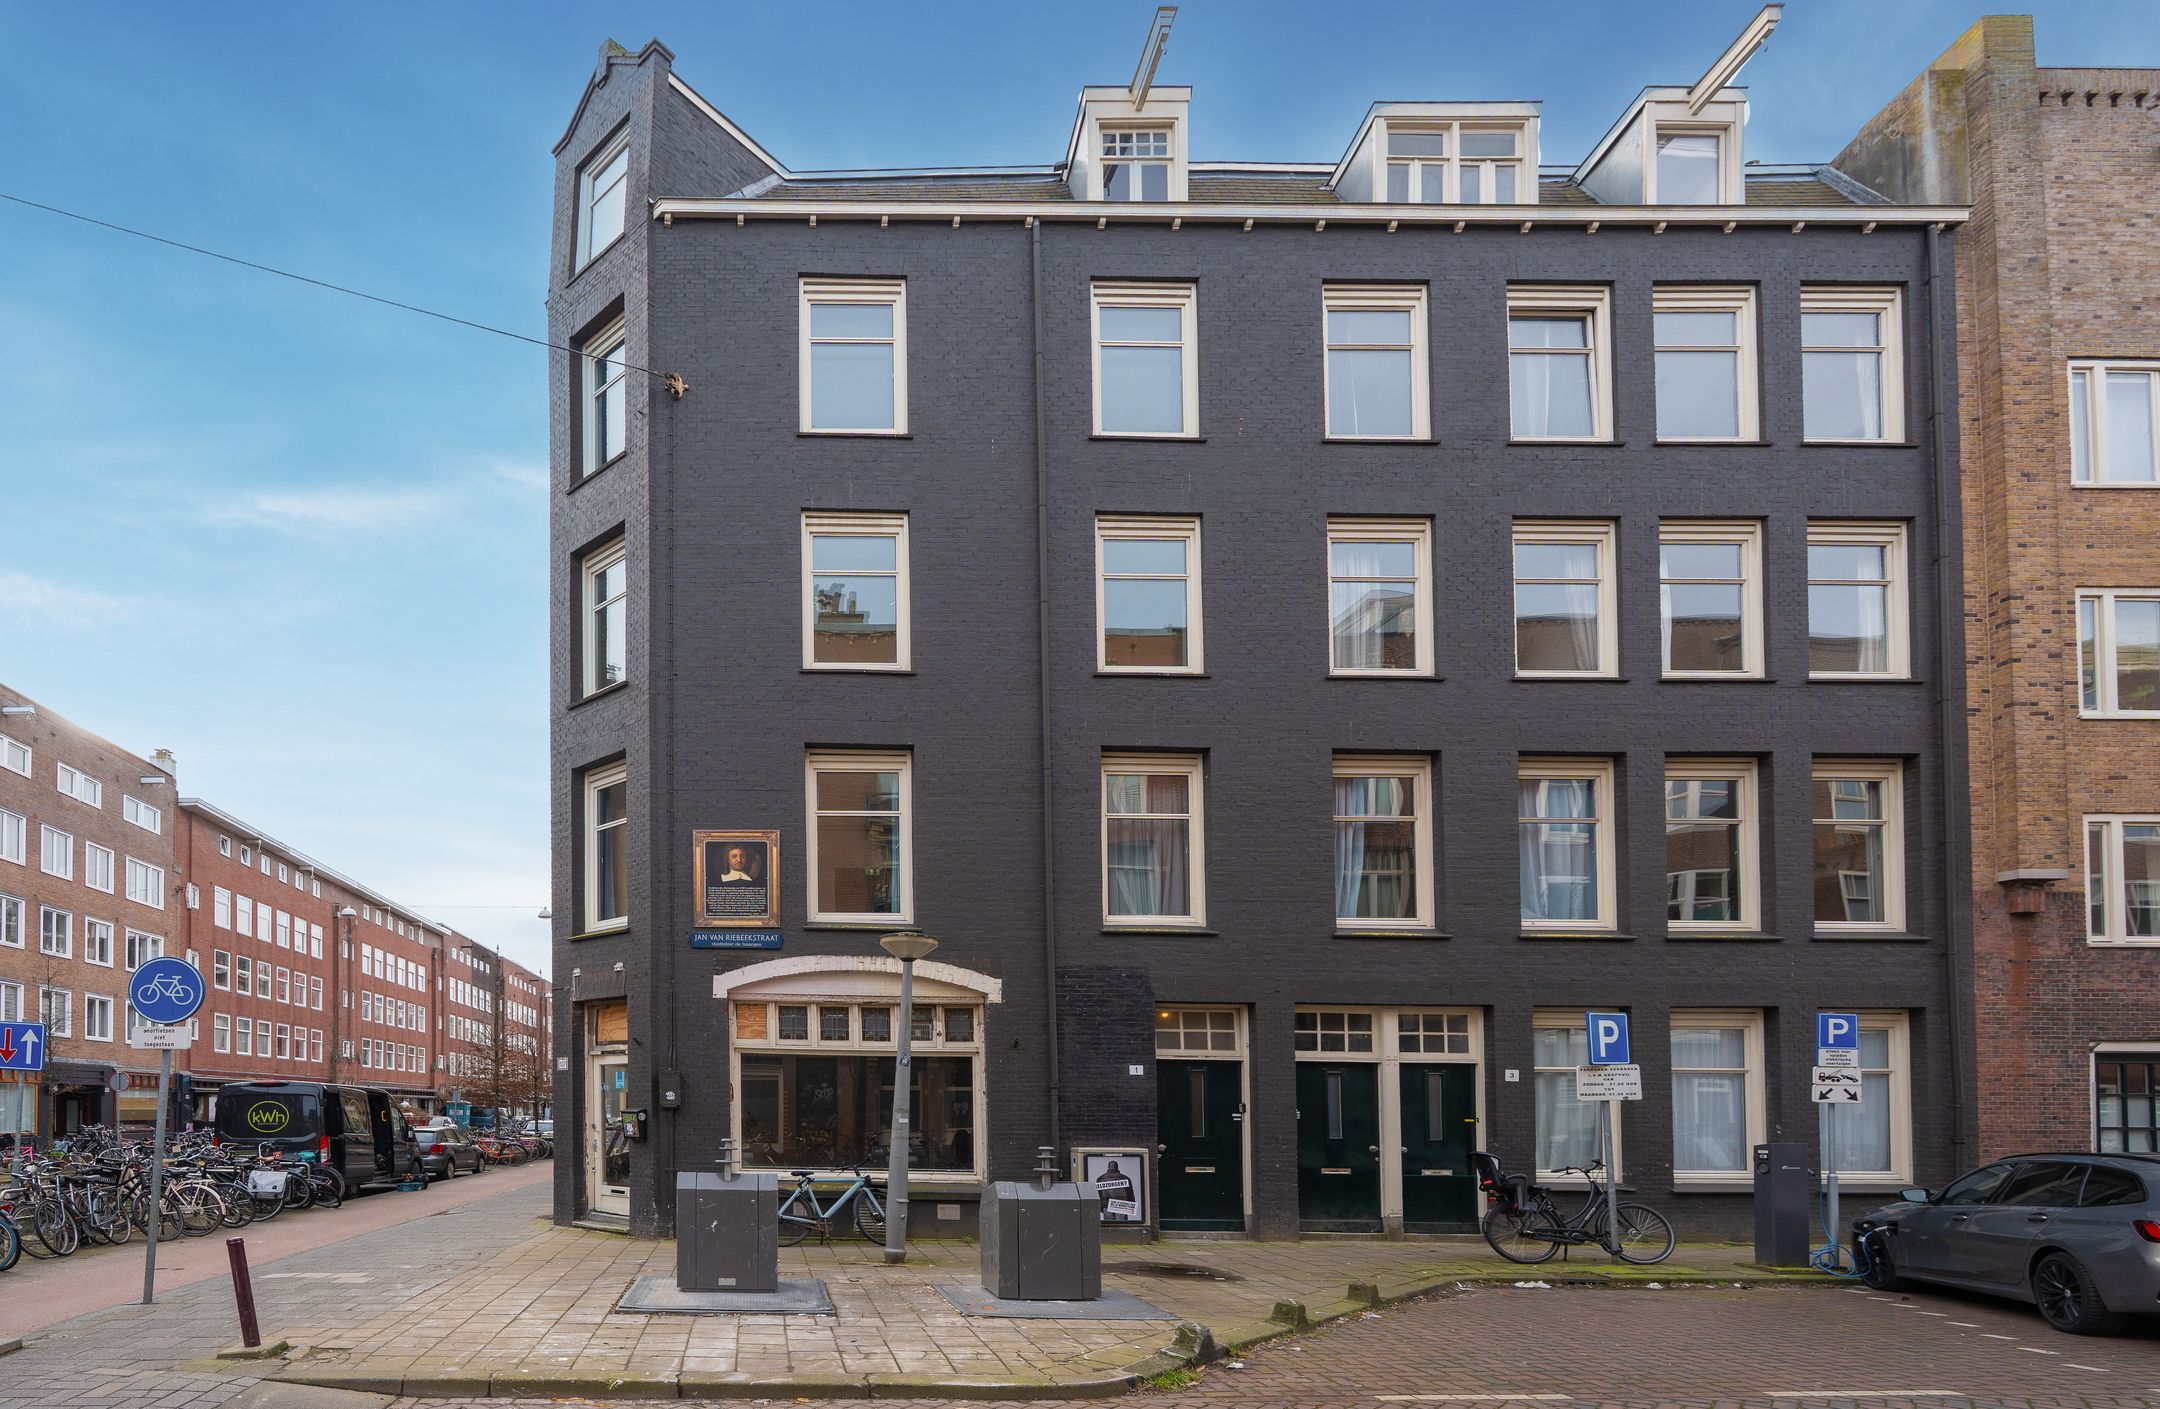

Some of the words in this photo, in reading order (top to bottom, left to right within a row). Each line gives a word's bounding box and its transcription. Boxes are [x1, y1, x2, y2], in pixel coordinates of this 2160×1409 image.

[694, 933, 708, 942] JAN
[709, 933, 724, 941] VAN
[725, 934, 779, 942] RIEBEEKSTRAAT
[1598, 1019, 1619, 1057] P
[1828, 1018, 1849, 1044] P
[252, 1109, 285, 1123] kWh
[1096, 1180, 1128, 1189] ELDZORGEN?
